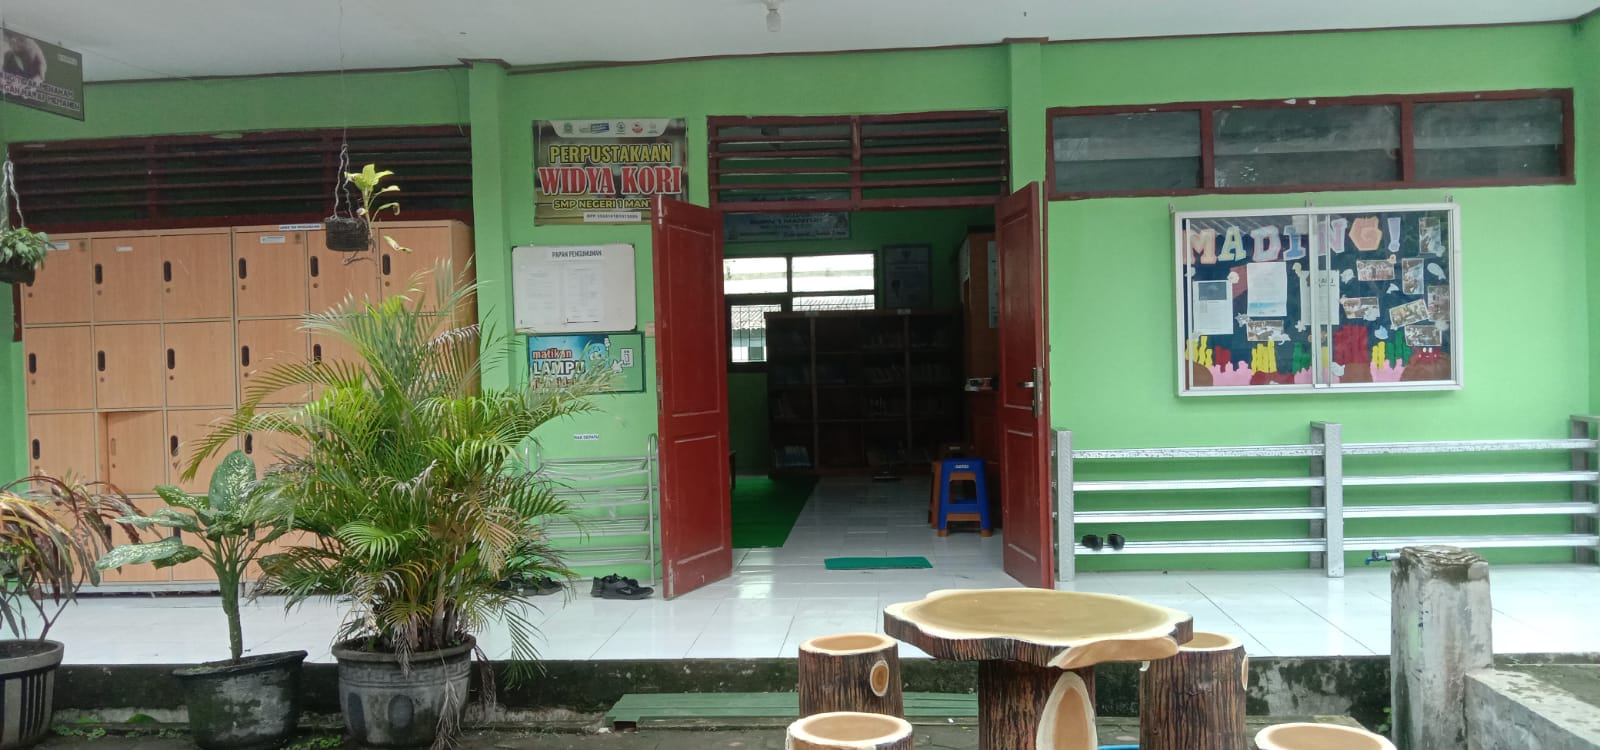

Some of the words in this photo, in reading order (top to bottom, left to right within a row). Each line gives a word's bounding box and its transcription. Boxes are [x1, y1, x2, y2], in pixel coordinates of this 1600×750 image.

[549, 144, 672, 164] PERPUSTAKAAN
[538, 166, 617, 195] WIDYA
[621, 166, 683, 195] KORI
[553, 199, 578, 210] SMP
[578, 199, 617, 210] NEGERI
[617, 199, 623, 209] 1
[1182, 216, 1401, 265] MADING!
[569, 249, 602, 257] PENGUMUMAN
[532, 348, 572, 360] matikan
[533, 360, 585, 375] LAMPU
